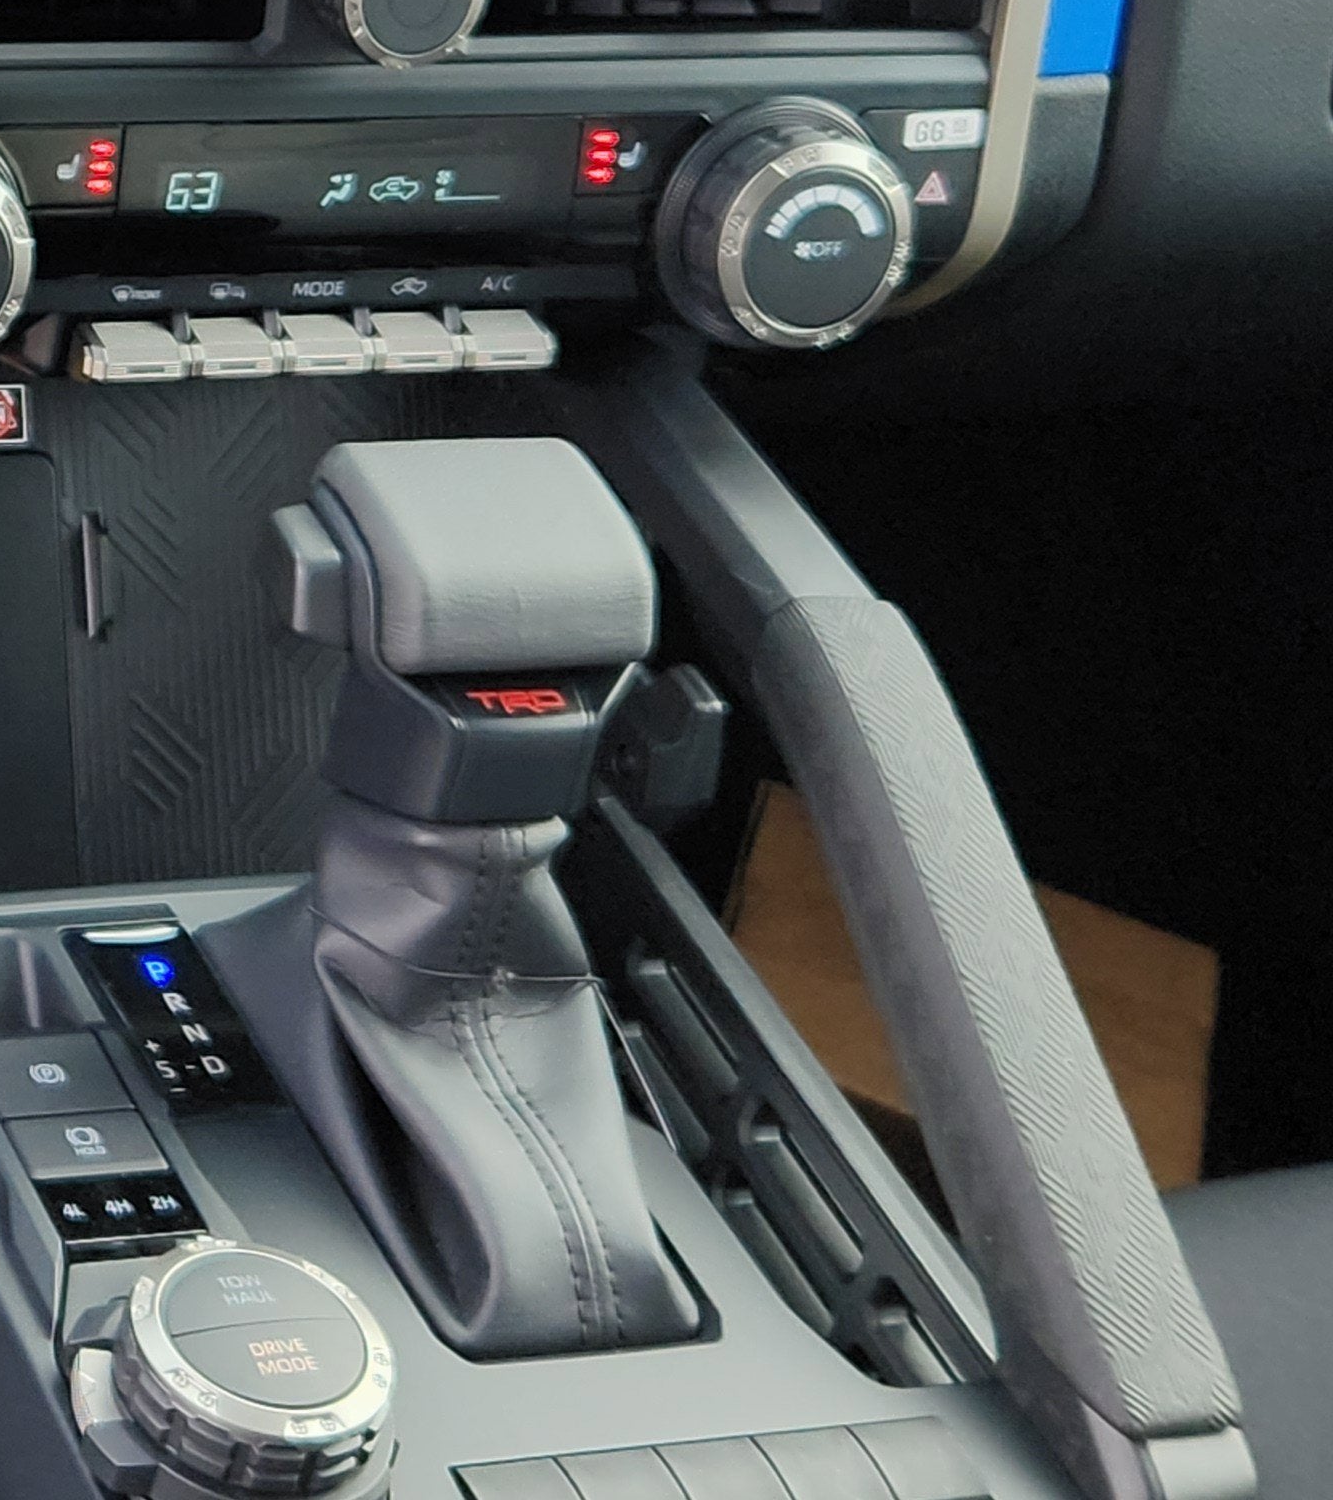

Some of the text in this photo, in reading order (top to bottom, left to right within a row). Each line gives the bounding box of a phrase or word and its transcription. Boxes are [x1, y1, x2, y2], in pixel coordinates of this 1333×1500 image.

[165, 171, 223, 213] 63
[811, 241, 842, 257] OFF
[293, 281, 345, 297] MODE
[481, 276, 514, 292] A/C
[465, 688, 567, 714] TRD
[145, 961, 170, 983] P
[163, 993, 191, 1014] R
[181, 1024, 210, 1044] N
[156, 1055, 227, 1079] S D
[74, 1145, 107, 1156] HOLD
[62, 1202, 86, 1219] 4L
[105, 1199, 133, 1214] 4H
[149, 1196, 177, 1211] 2H
[217, 1275, 262, 1290] TOW
[223, 1292, 277, 1306] HAUL
[249, 1338, 309, 1357] DRIVE
[257, 1357, 320, 1377] MODE
